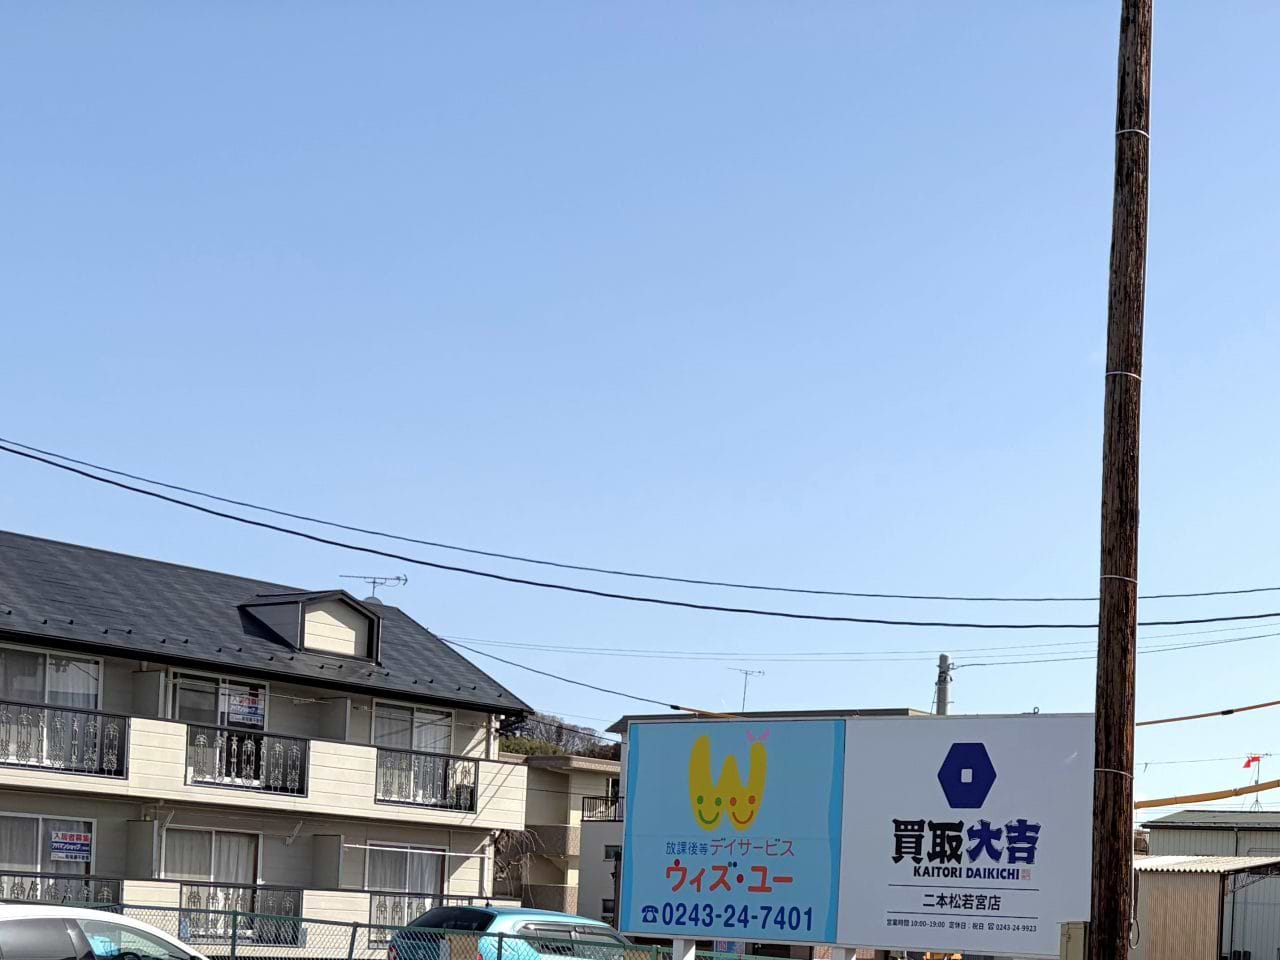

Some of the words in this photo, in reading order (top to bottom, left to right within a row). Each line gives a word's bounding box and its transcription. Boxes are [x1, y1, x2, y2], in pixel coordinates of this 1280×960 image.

[665, 838, 795, 857] 放課後等デイサービス
[891, 818, 1041, 865] 買取大吉
[665, 858, 793, 893] ウィズ・ユー
[913, 866, 962, 878] KAITORI
[966, 867, 1020, 880] DAIKICHI
[923, 893, 1001, 911] 二本松若宮店
[662, 902, 813, 931] 0243-24-7401
[886, 918, 910, 927] 営業時間
